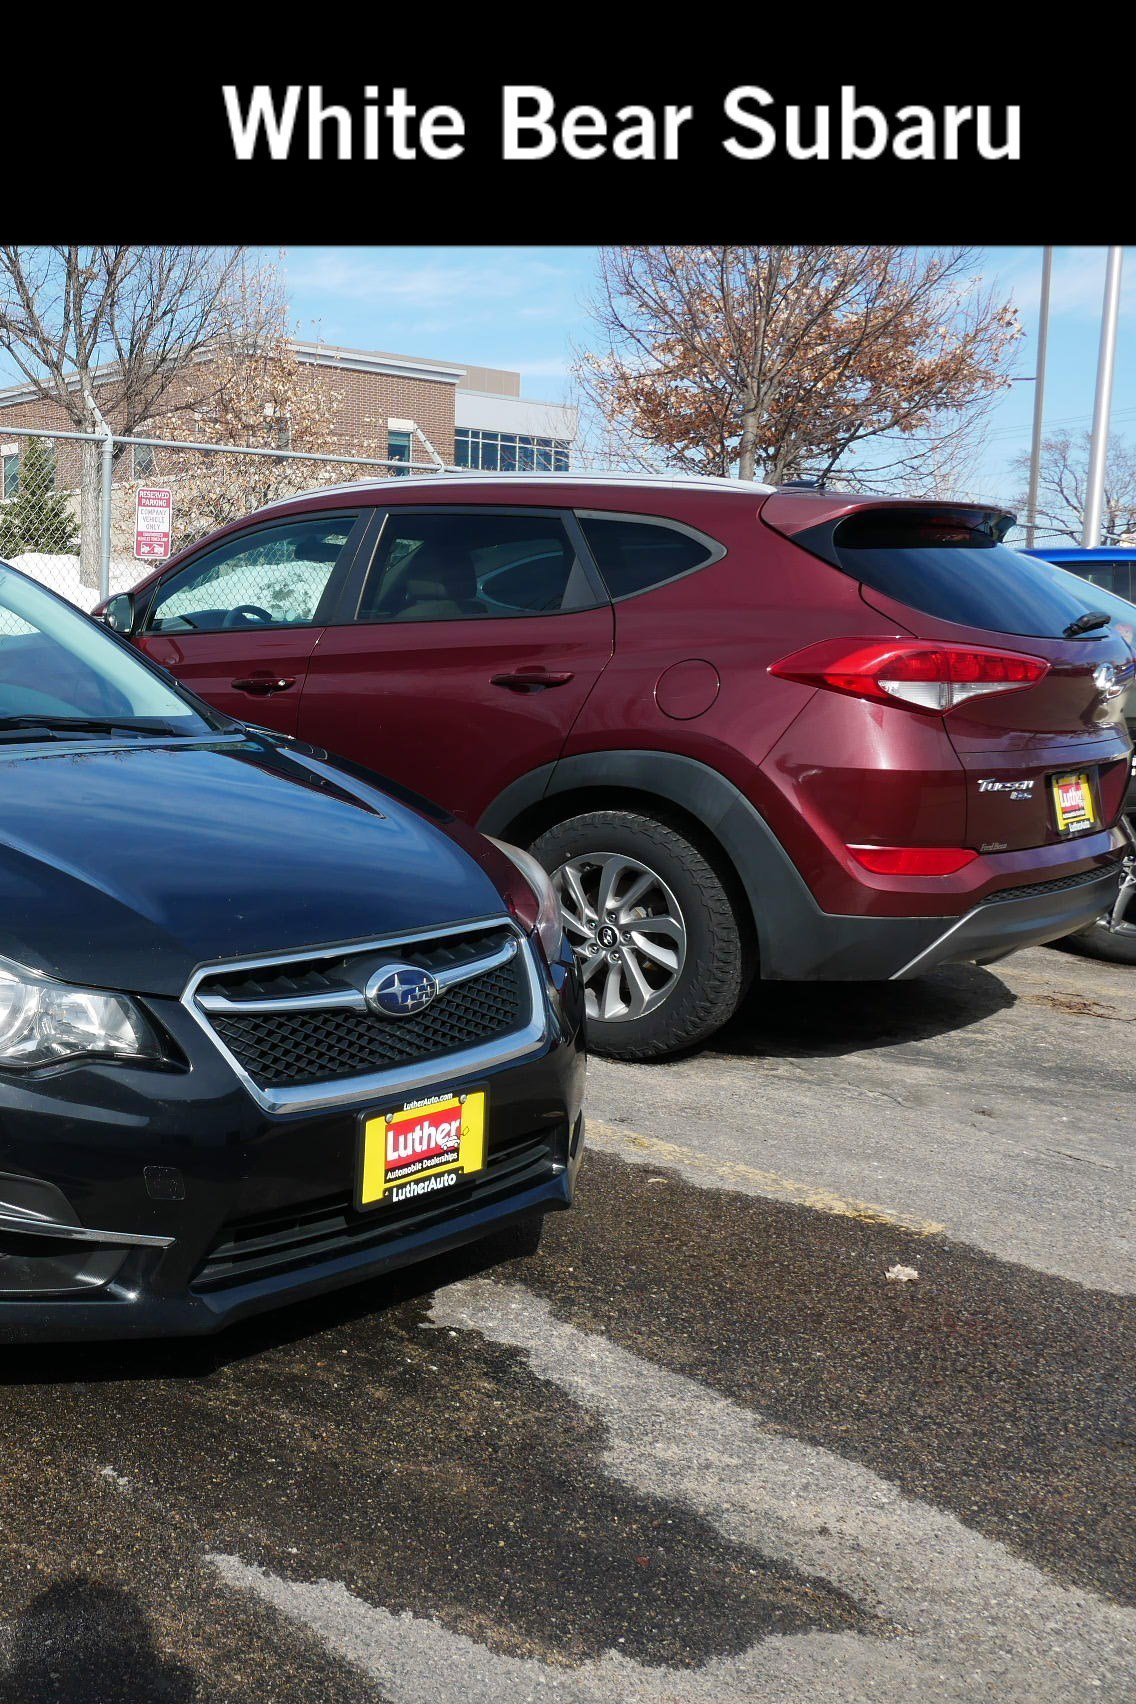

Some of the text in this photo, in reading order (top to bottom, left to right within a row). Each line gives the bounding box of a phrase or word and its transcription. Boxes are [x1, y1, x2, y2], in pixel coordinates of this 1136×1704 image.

[139, 491, 169, 499] RESERVED
[140, 508, 167, 516] COMPANY
[142, 516, 165, 524] VEHICLE
[145, 523, 161, 531] ONLY
[977, 778, 1034, 792] Tucson
[403, 1093, 453, 1111] LutherAuto.com
[386, 1119, 461, 1161] Luther
[386, 1152, 458, 1180] Automobile Dealerships
[392, 1173, 457, 1202] LutherAuto
